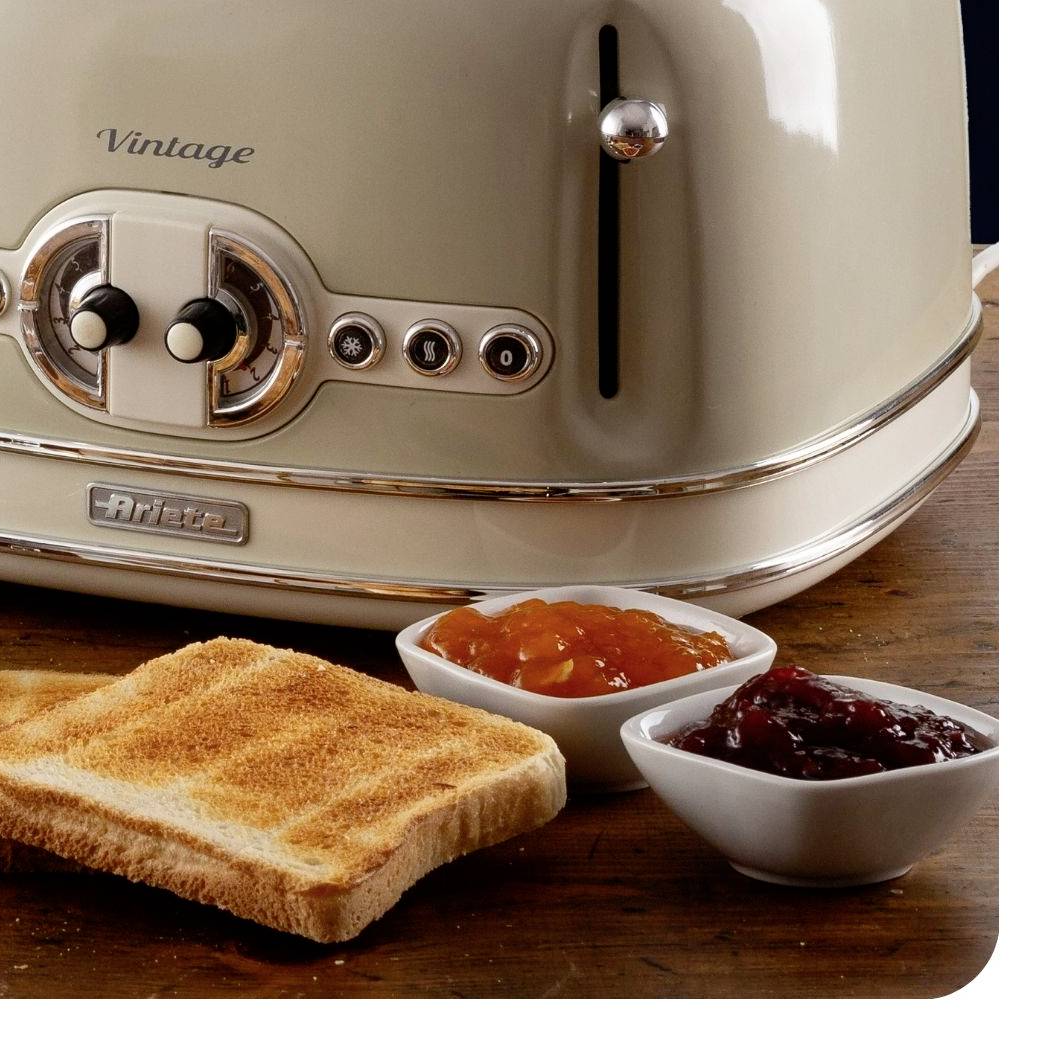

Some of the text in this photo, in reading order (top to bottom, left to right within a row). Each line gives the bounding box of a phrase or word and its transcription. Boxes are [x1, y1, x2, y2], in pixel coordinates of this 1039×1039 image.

[96, 128, 256, 169] Vintage
[500, 349, 513, 367] 0
[94, 493, 239, 536] Ariete
